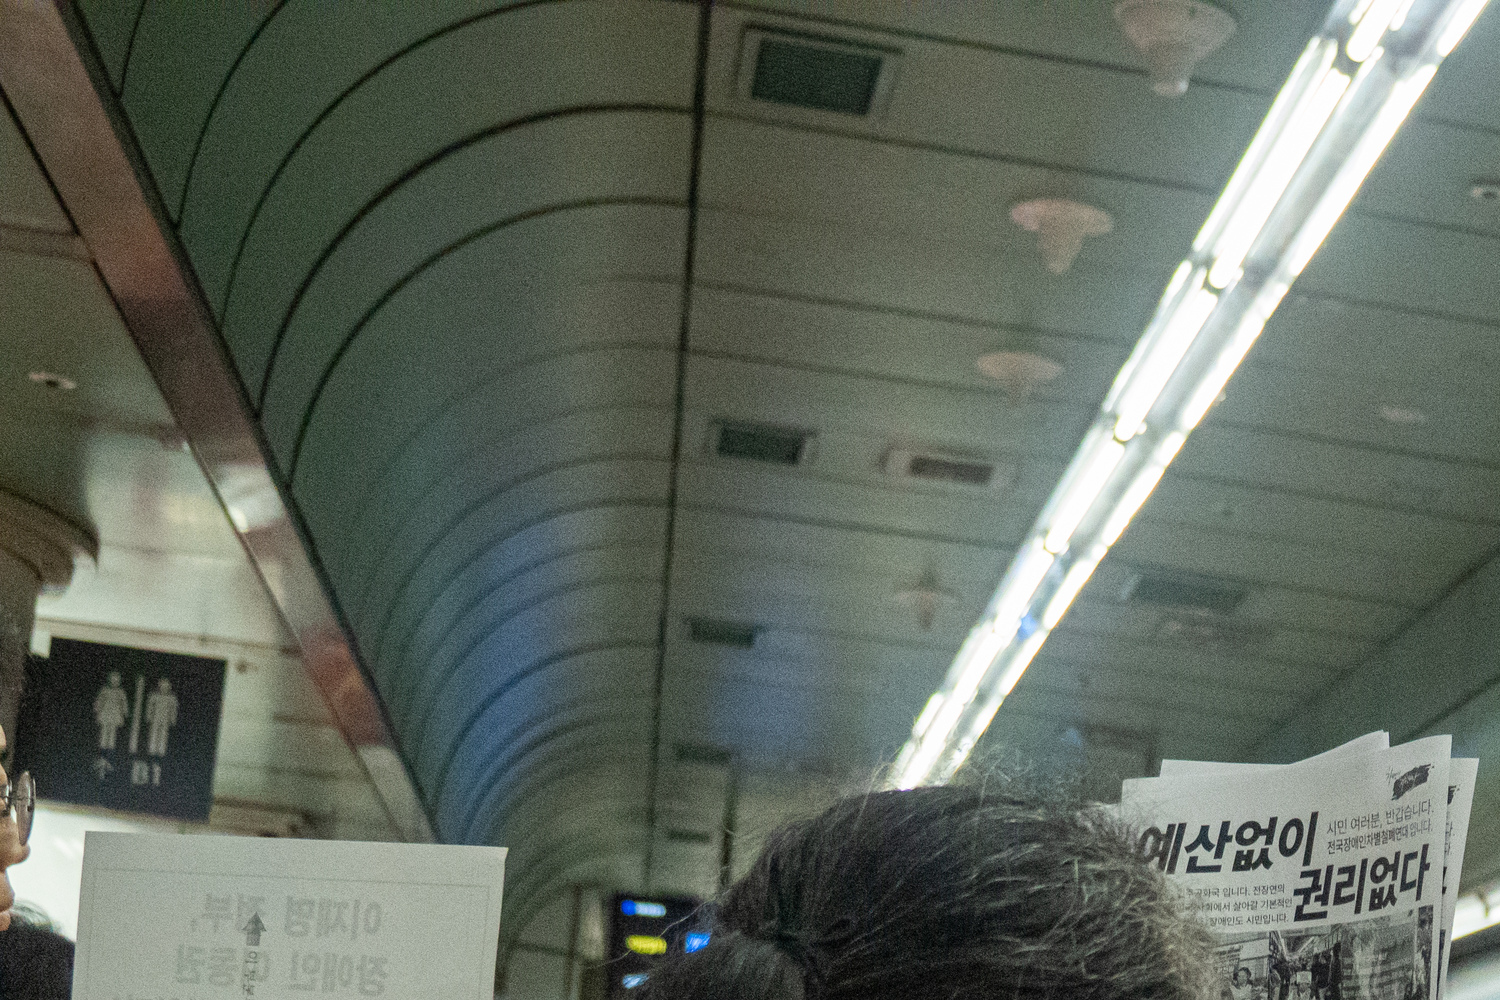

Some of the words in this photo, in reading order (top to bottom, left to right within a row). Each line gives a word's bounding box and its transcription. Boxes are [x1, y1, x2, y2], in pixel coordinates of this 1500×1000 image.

[1140, 811, 1319, 875] 예산없이
[1327, 818, 1347, 836] 시민
[1293, 843, 1430, 922] 권리없다
